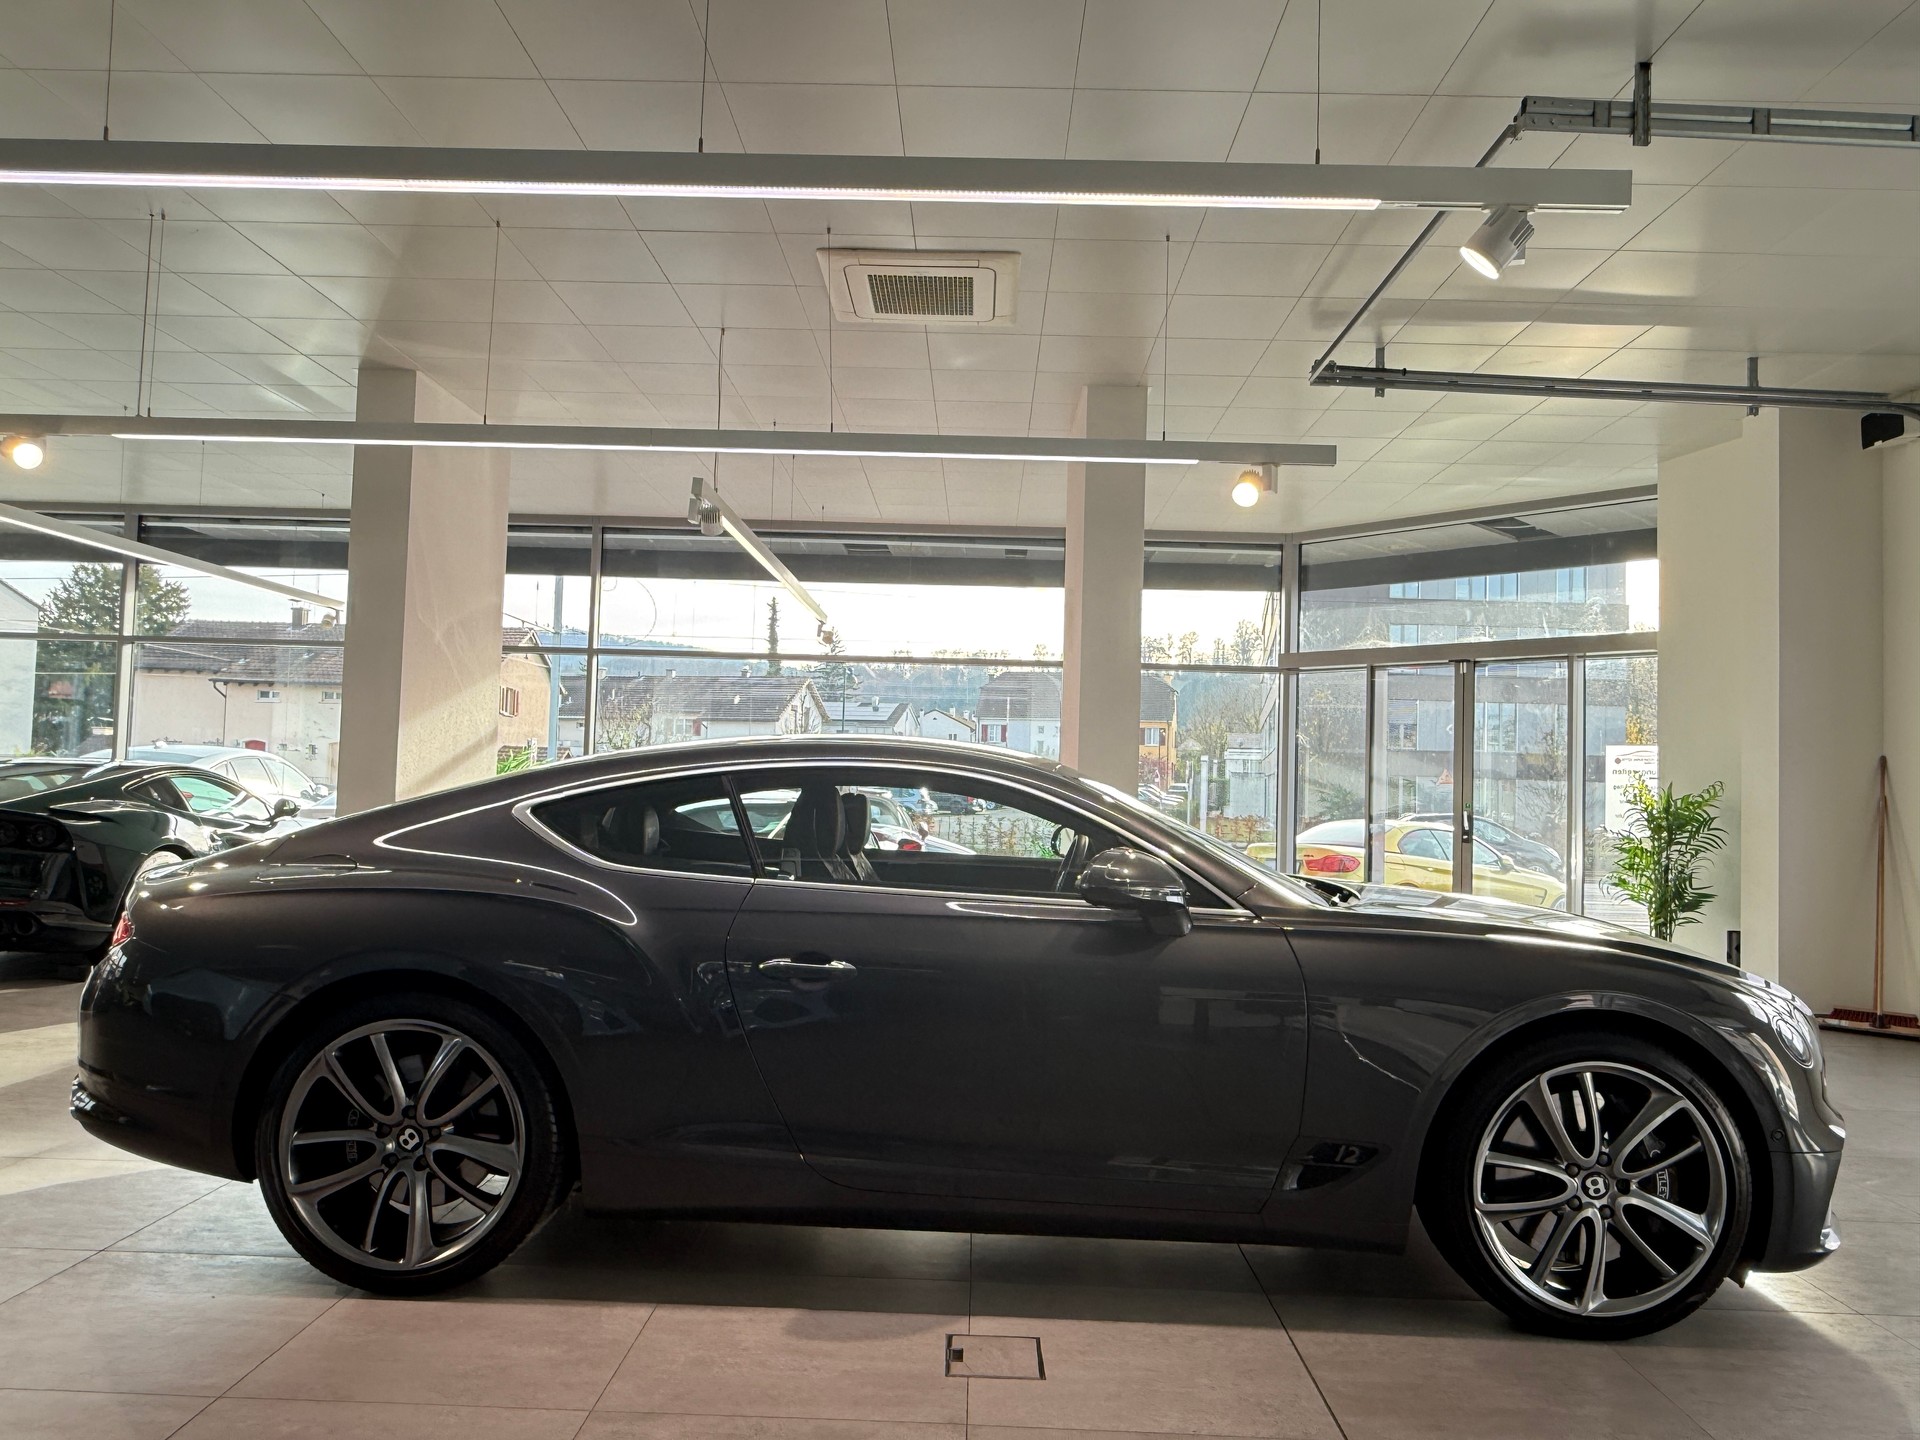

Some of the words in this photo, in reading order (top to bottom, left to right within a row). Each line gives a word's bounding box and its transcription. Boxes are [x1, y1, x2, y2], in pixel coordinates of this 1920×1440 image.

[399, 1128, 420, 1150] B
[1334, 1144, 1360, 1164] 12
[1585, 1176, 1606, 1197] B
